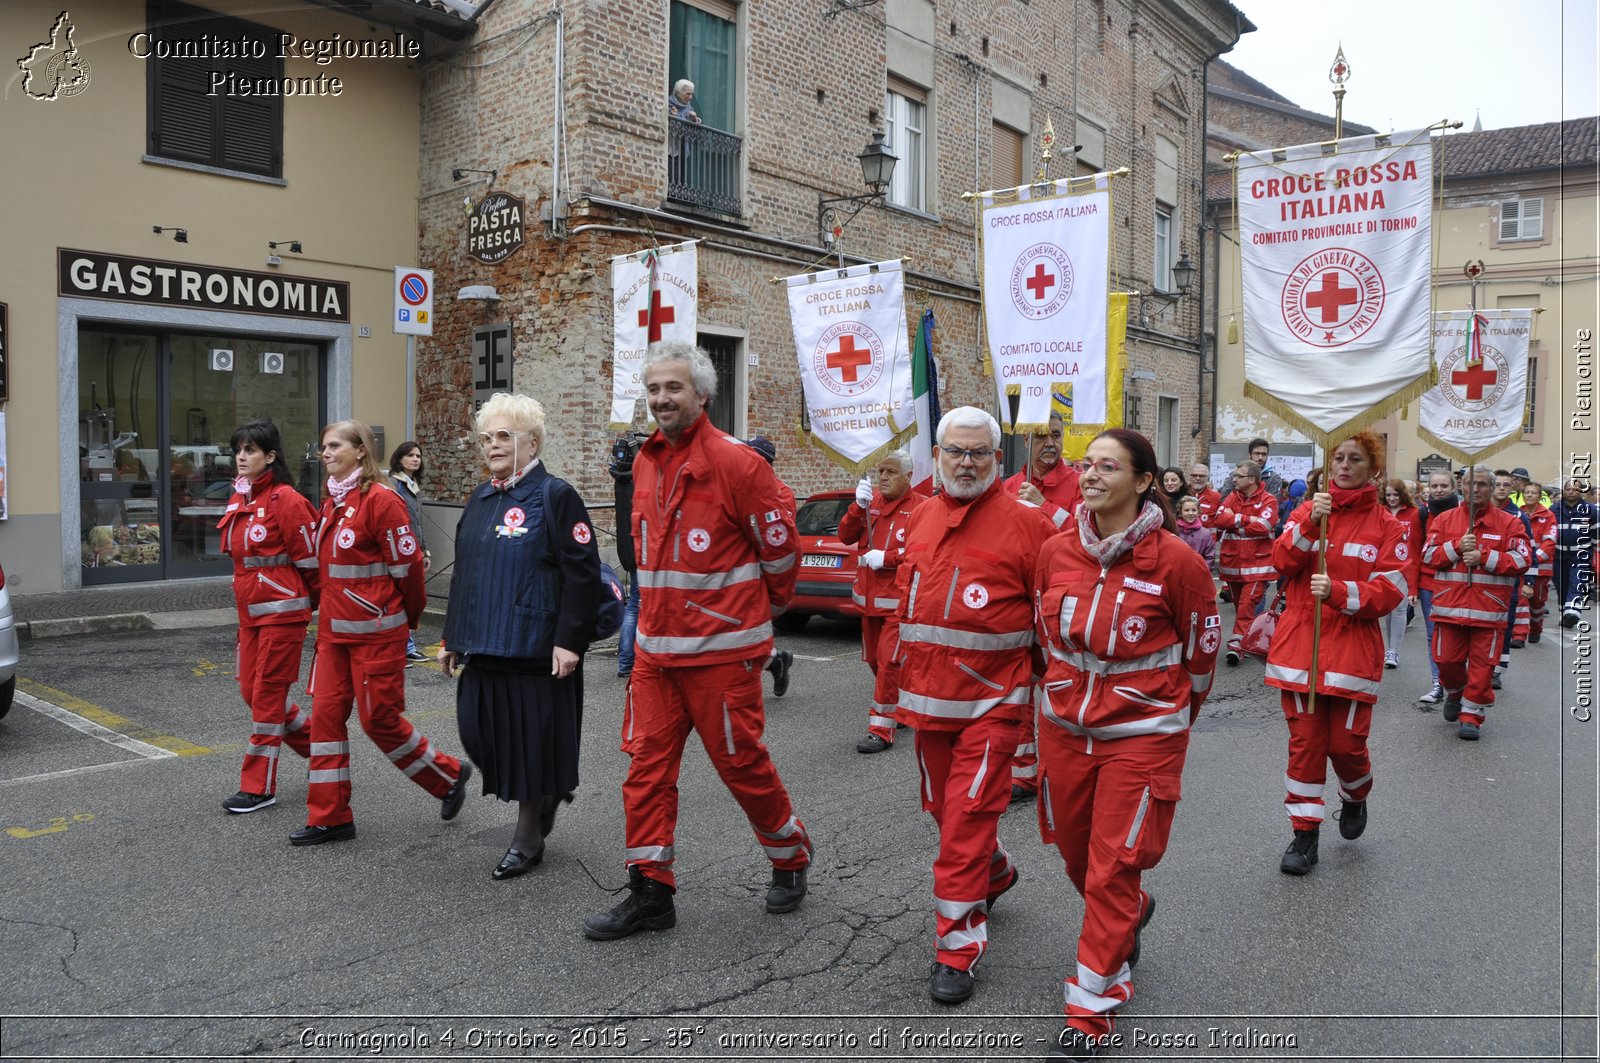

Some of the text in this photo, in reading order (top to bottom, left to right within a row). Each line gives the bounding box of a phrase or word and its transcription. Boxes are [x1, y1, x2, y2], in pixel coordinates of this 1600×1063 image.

[1252, 160, 1418, 199] CROCE ROSSA
[990, 204, 1098, 228] CROCE ROSSA ITALIANA
[1280, 189, 1386, 222] ITALIANA
[470, 206, 520, 234] PASTA
[1253, 216, 1417, 245] COMITATO PROVINCIALE DI TORINO
[470, 228, 521, 252] FRESCA
[482, 252, 493, 260] DAL
[70, 258, 342, 316] GASTRONOMIA
[616, 284, 638, 310] CROCE
[638, 273, 660, 288] ROSA
[1013, 245, 1072, 316] CONVENZIONE DI GINEVRA 22 AGOSTO 1864
[806, 284, 884, 304] CROCE ROSSA
[1286, 252, 1381, 338] CONVENZIONE DI GINEVRA 22 AGOSTO 1864
[818, 300, 871, 316] ITALIANA
[1490, 328, 1528, 336] ITALIANA
[816, 323, 882, 392] CONVENZIONE DI GINEVRA 22 AGOSTO 1864
[1000, 341, 1083, 356] COMITATO LOCALE
[1002, 362, 1080, 378] CARMAGNOLA
[1026, 386, 1044, 397] (TO)
[812, 405, 856, 418] COMITATO
[824, 416, 886, 432] NICHELINO
[1444, 418, 1498, 428] AIRASCA
[811, 556, 836, 566] 920VZ
